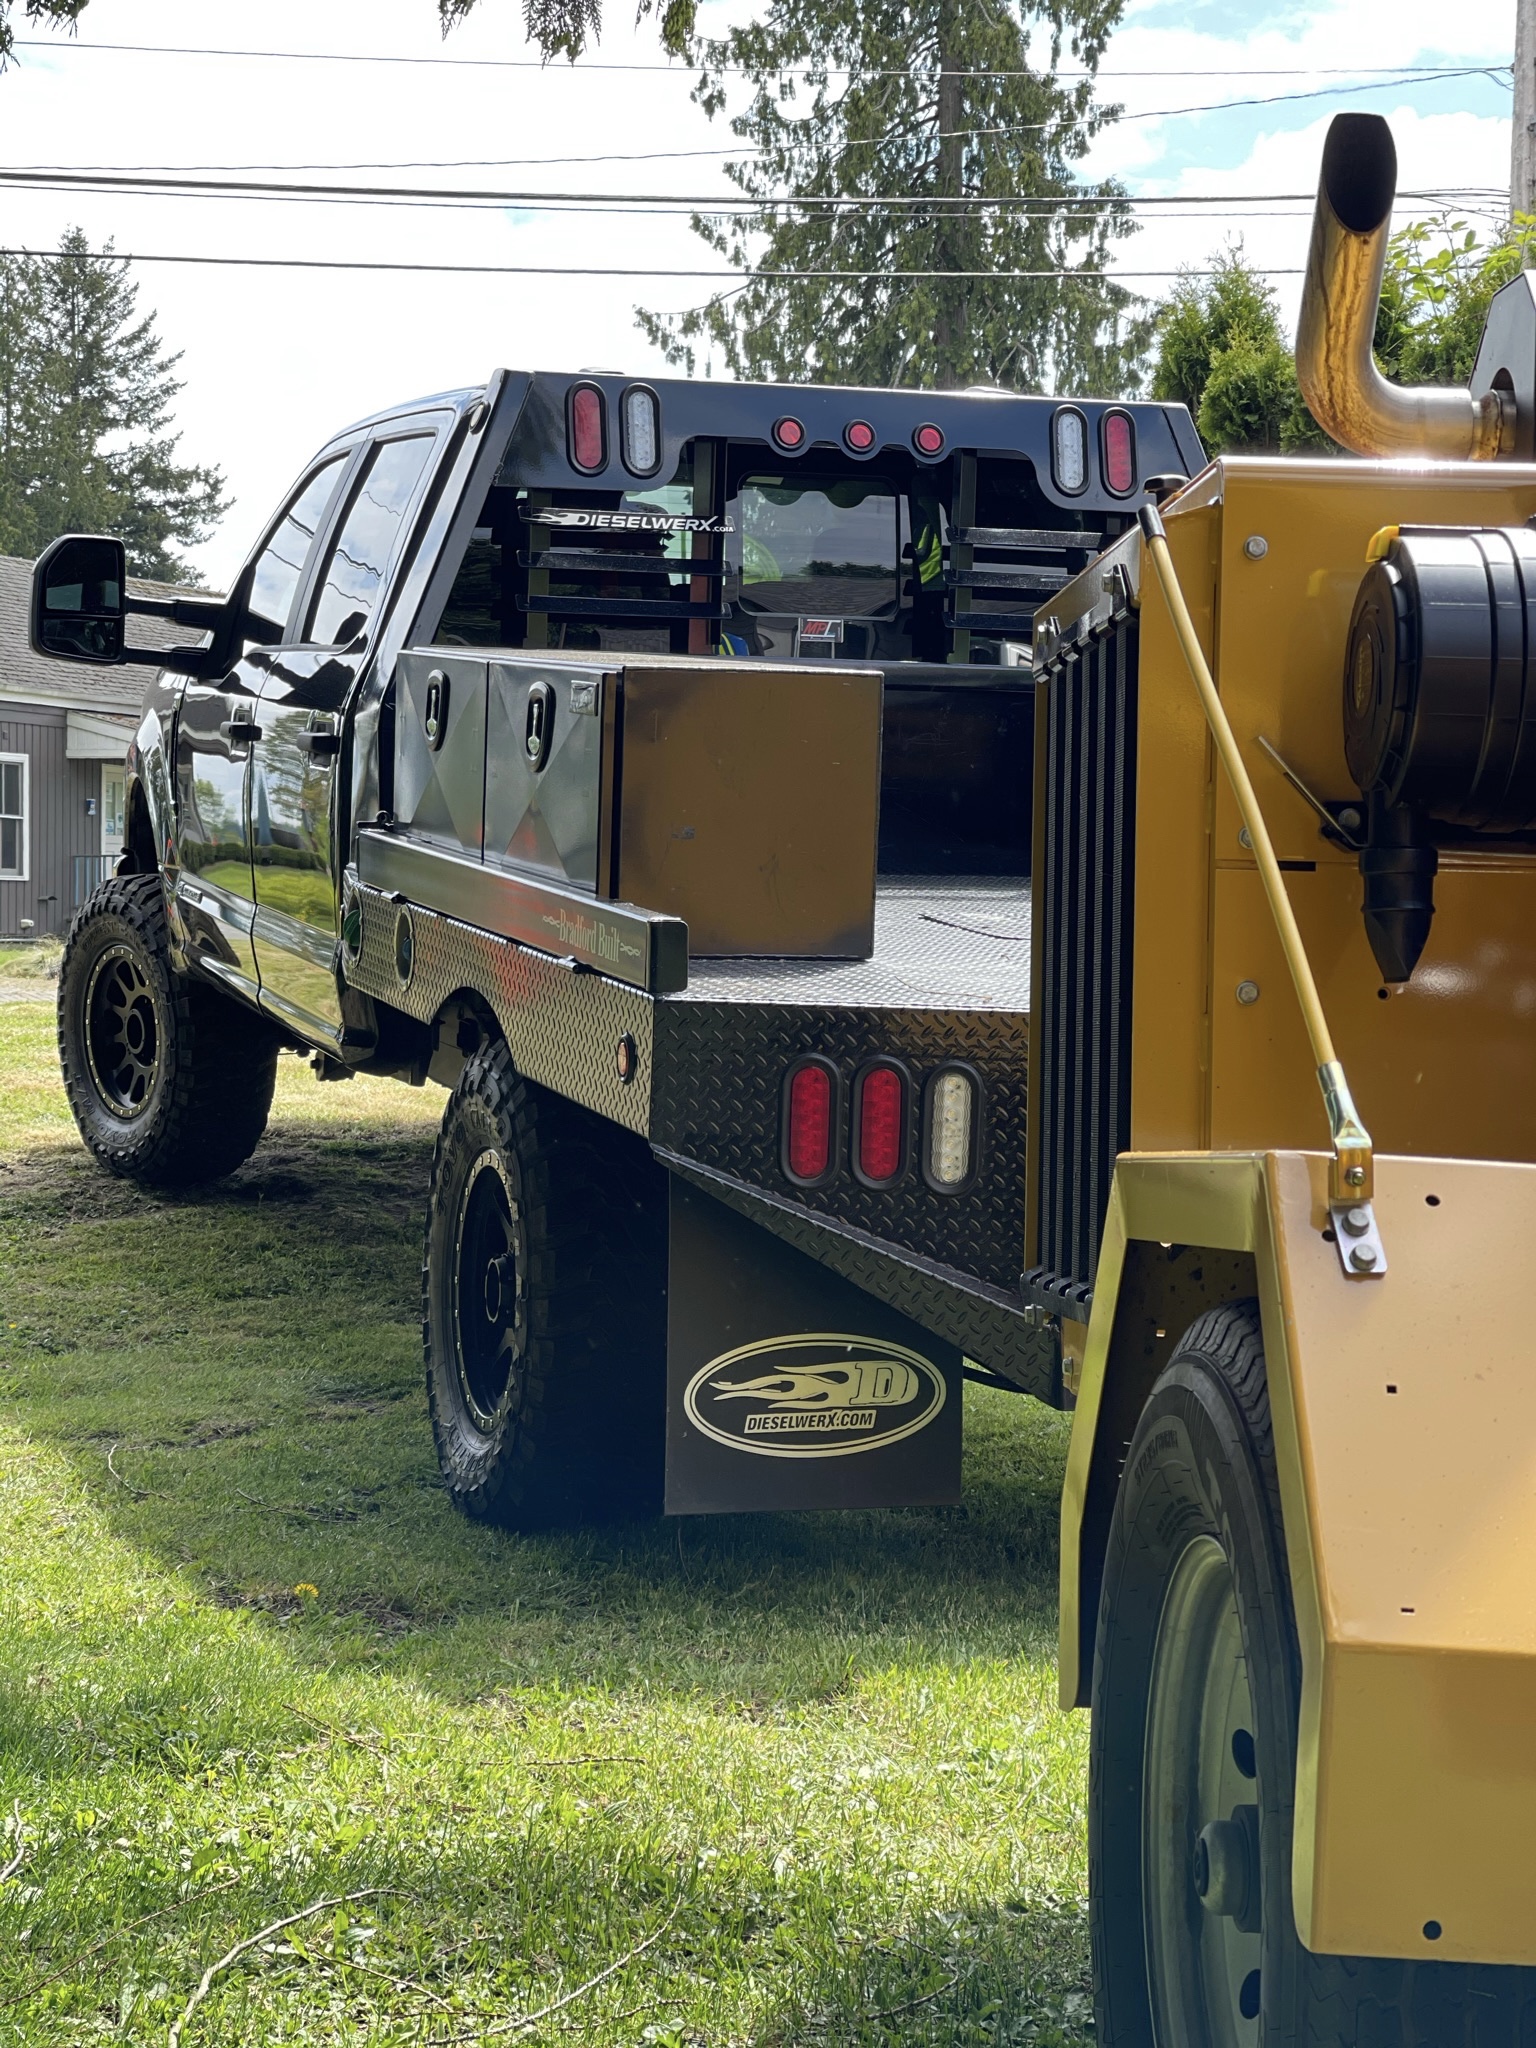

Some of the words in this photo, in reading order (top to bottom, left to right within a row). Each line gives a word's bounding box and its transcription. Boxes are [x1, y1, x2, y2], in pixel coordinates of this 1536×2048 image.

[559, 909, 597, 954] Bradford
[599, 922, 620, 963] Built
[97, 1122, 137, 1146] TOYO
[434, 1120, 466, 1217] TOYO
[747, 1410, 873, 1431] DIESELWERX.COM
